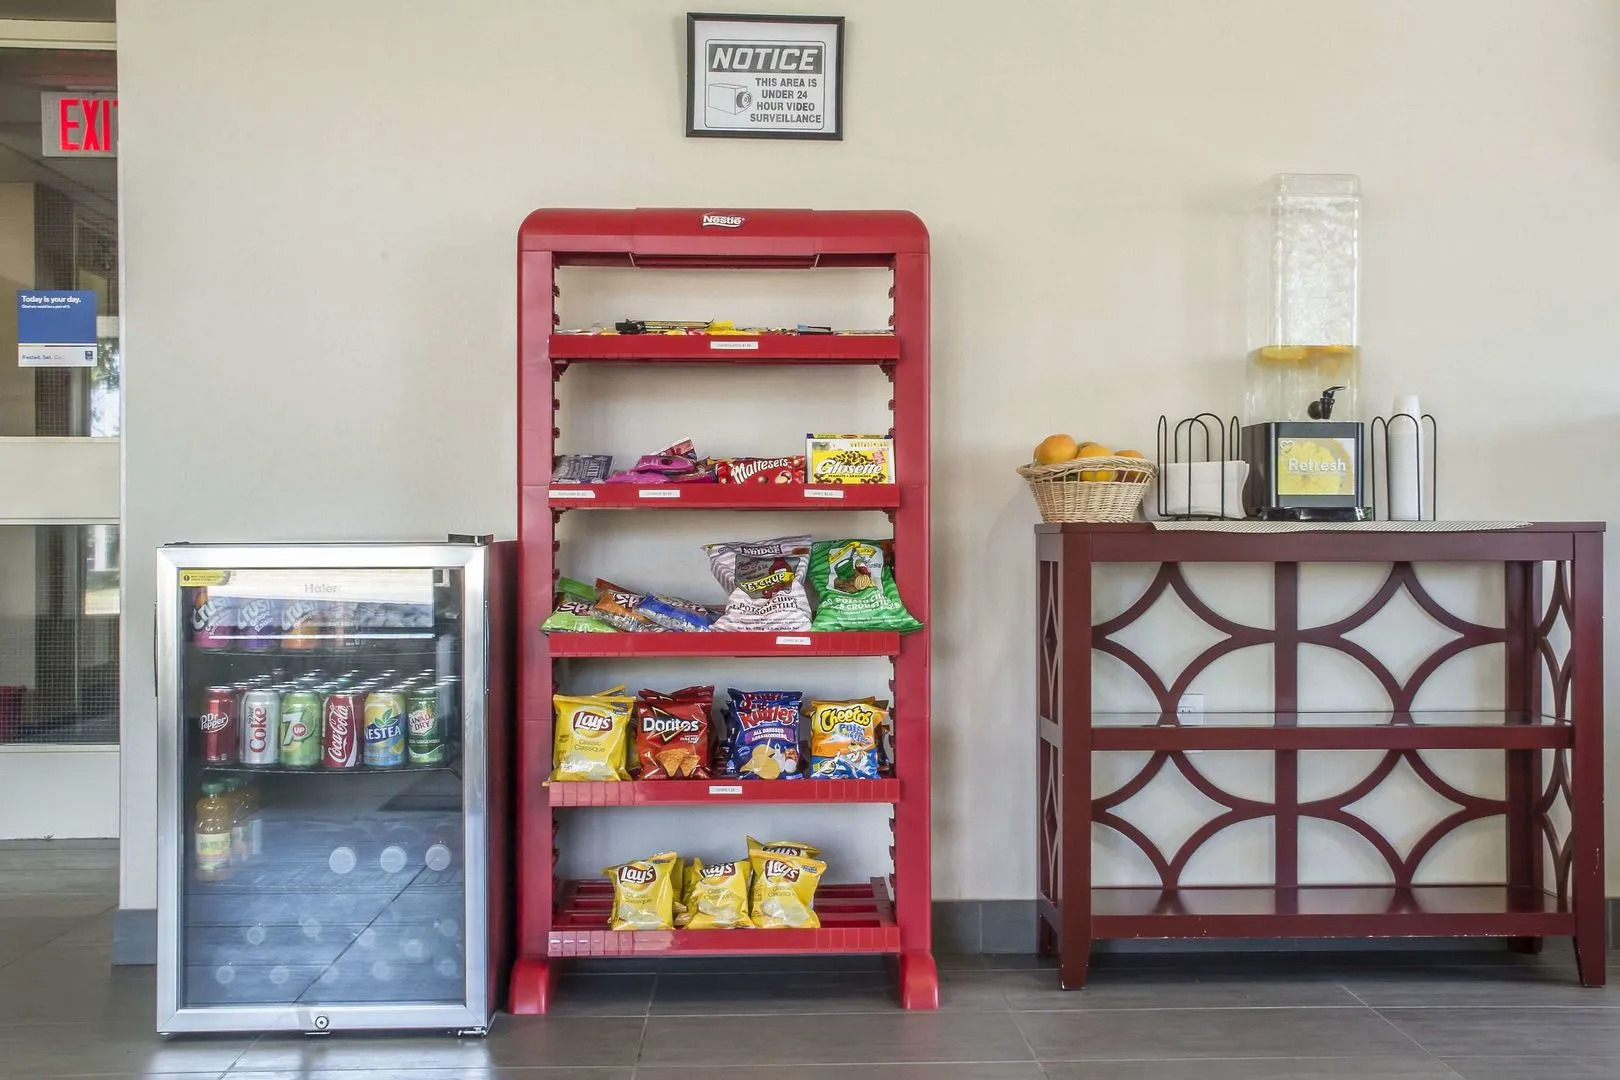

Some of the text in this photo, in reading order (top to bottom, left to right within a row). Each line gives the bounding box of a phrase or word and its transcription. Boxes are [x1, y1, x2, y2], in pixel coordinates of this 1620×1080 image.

[712, 47, 819, 71] NOTICE
[755, 77, 817, 88] THIS AREA IS
[762, 90, 808, 99] UNDER 24
[756, 102, 815, 112] HOUR VIDEO
[750, 114, 821, 123] SURVEILLANCE
[21, 295, 42, 304] Today
[44, 295, 49, 303] is
[67, 295, 82, 304] day.
[731, 458, 789, 484] Maltesers
[816, 458, 883, 475] Glosette
[1288, 458, 1347, 472] Refresh
[200, 715, 227, 731] Pepper
[207, 713, 219, 722] Dr
[643, 717, 699, 732] Doritos
[820, 706, 873, 732] Cheetos
[250, 707, 266, 753] Coke
[282, 711, 304, 747] 7
[365, 725, 401, 741] NESTEA
[414, 720, 430, 731] DRY
